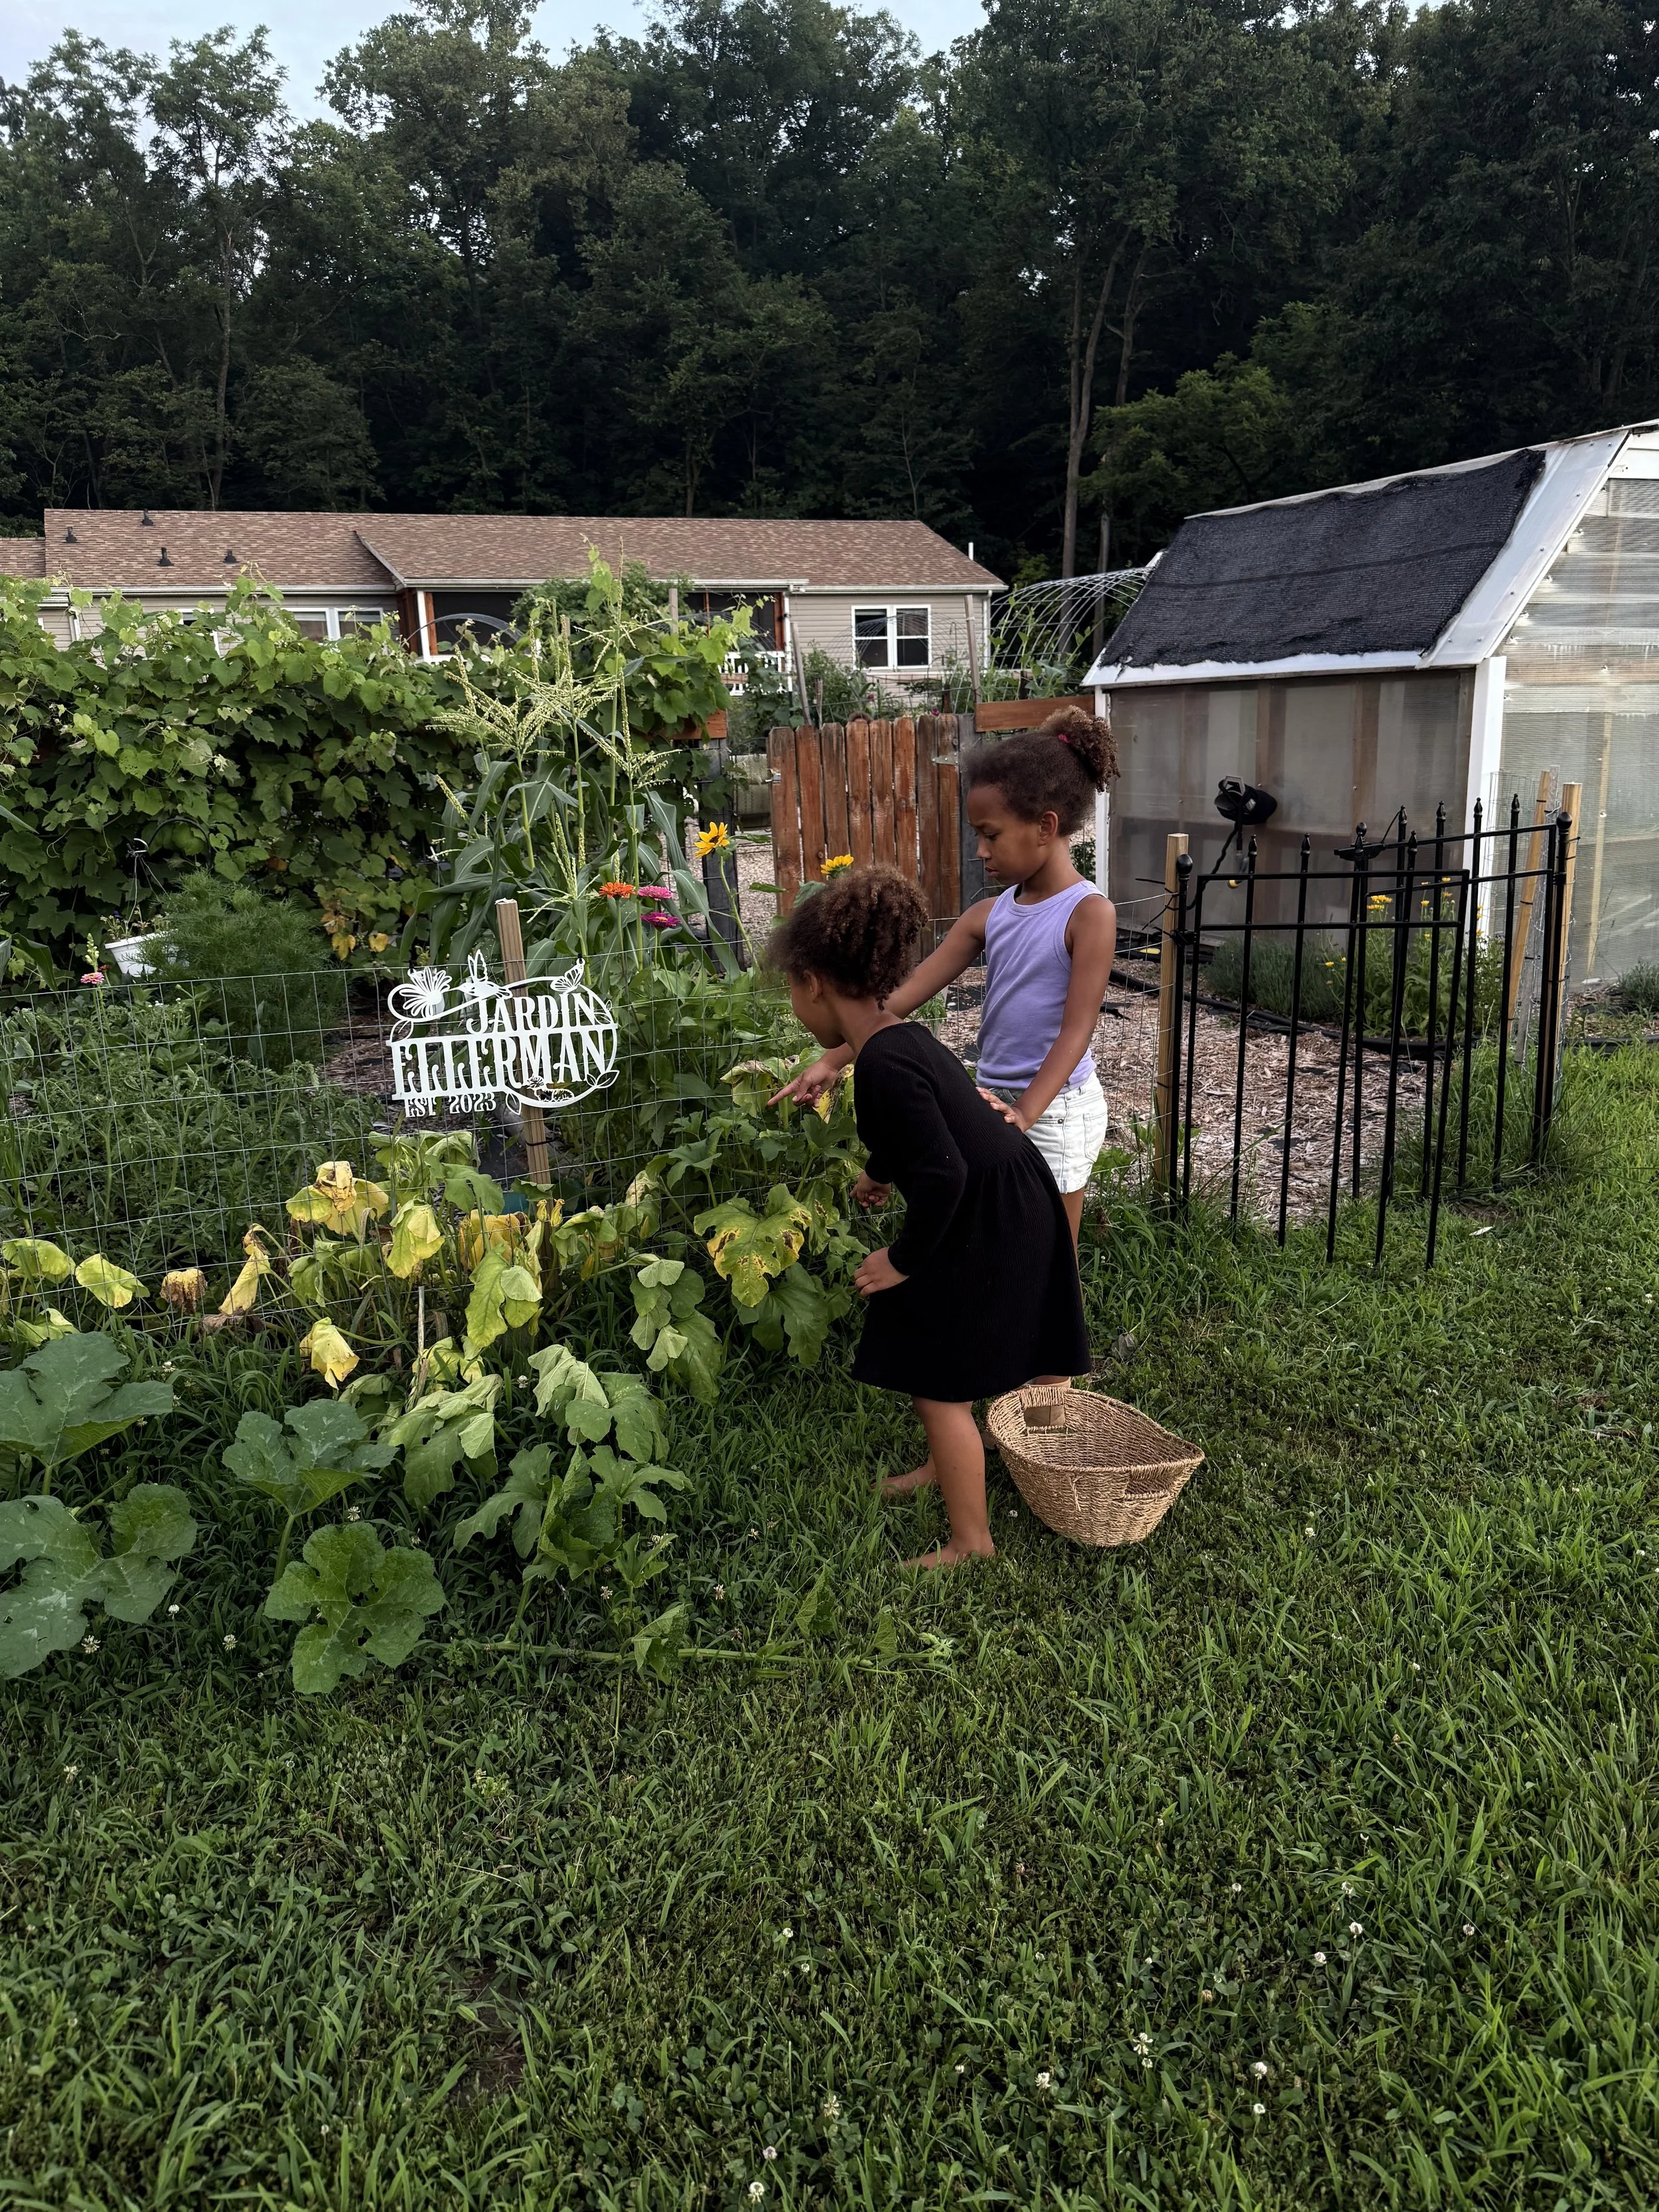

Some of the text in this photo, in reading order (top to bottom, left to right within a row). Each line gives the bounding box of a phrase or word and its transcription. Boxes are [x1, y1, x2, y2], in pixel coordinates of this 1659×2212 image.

[466, 992, 597, 1034] JARDIN
[391, 1029, 607, 1094] ELLERMAN
[404, 1093, 496, 1118] EST 2023
